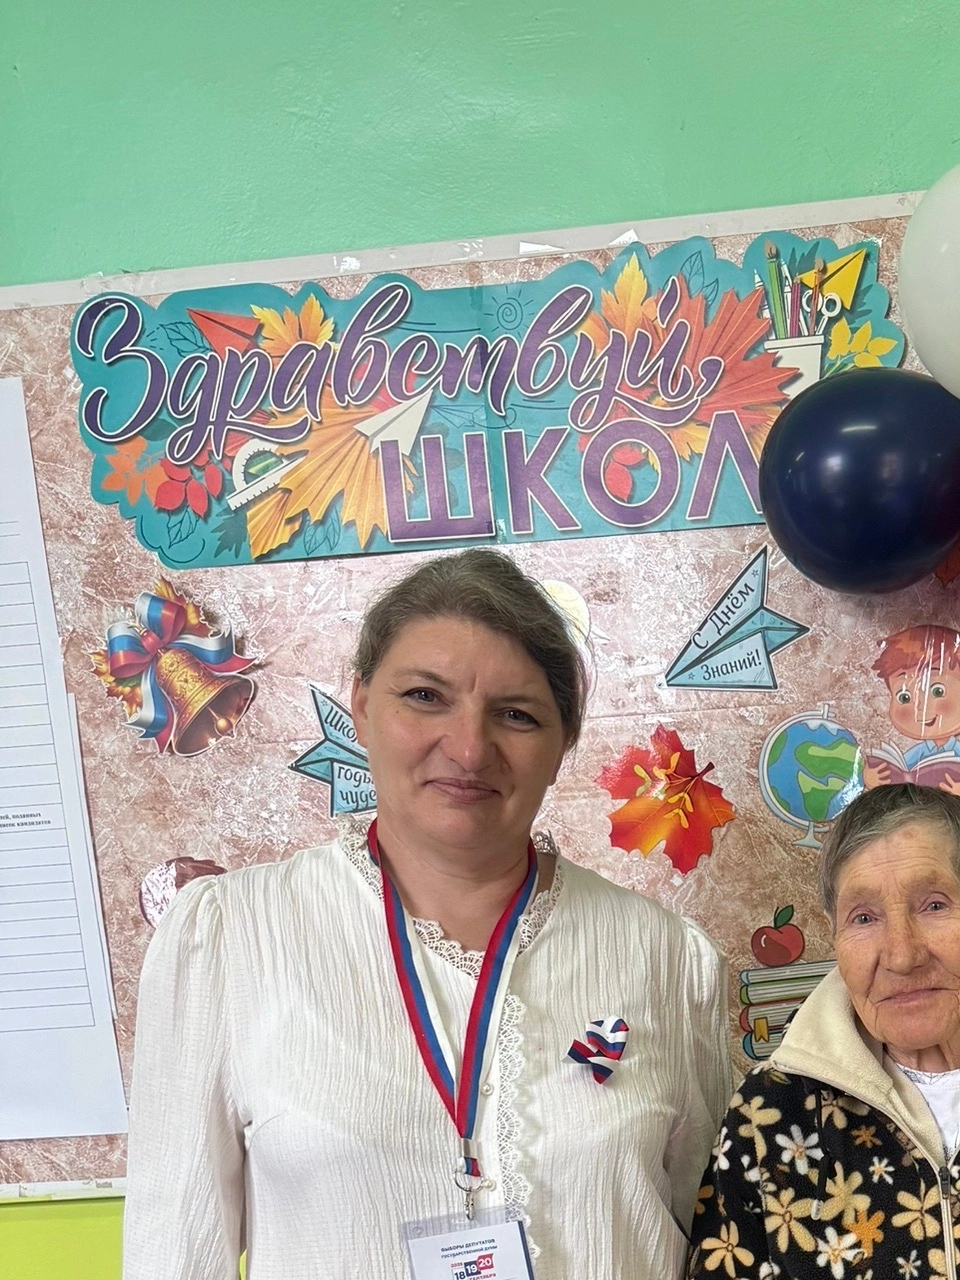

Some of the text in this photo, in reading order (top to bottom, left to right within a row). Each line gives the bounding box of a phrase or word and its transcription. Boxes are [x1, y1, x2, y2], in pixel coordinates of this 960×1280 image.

[75, 275, 724, 466] Здравствуй,
[380, 411, 761, 542] ШКОЛ
[692, 583, 755, 649] С Днём
[701, 648, 762, 681] Знаний!
[324, 705, 357, 743] Шко
[339, 789, 377, 810] чуде
[441, 1238, 496, 1252] ВЫБОРЫ ДЕПУТАТОВ
[441, 1247, 484, 1259] ГОСУДАРСТВЕННОЙ
[454, 1257, 492, 1280] 18 19 20
